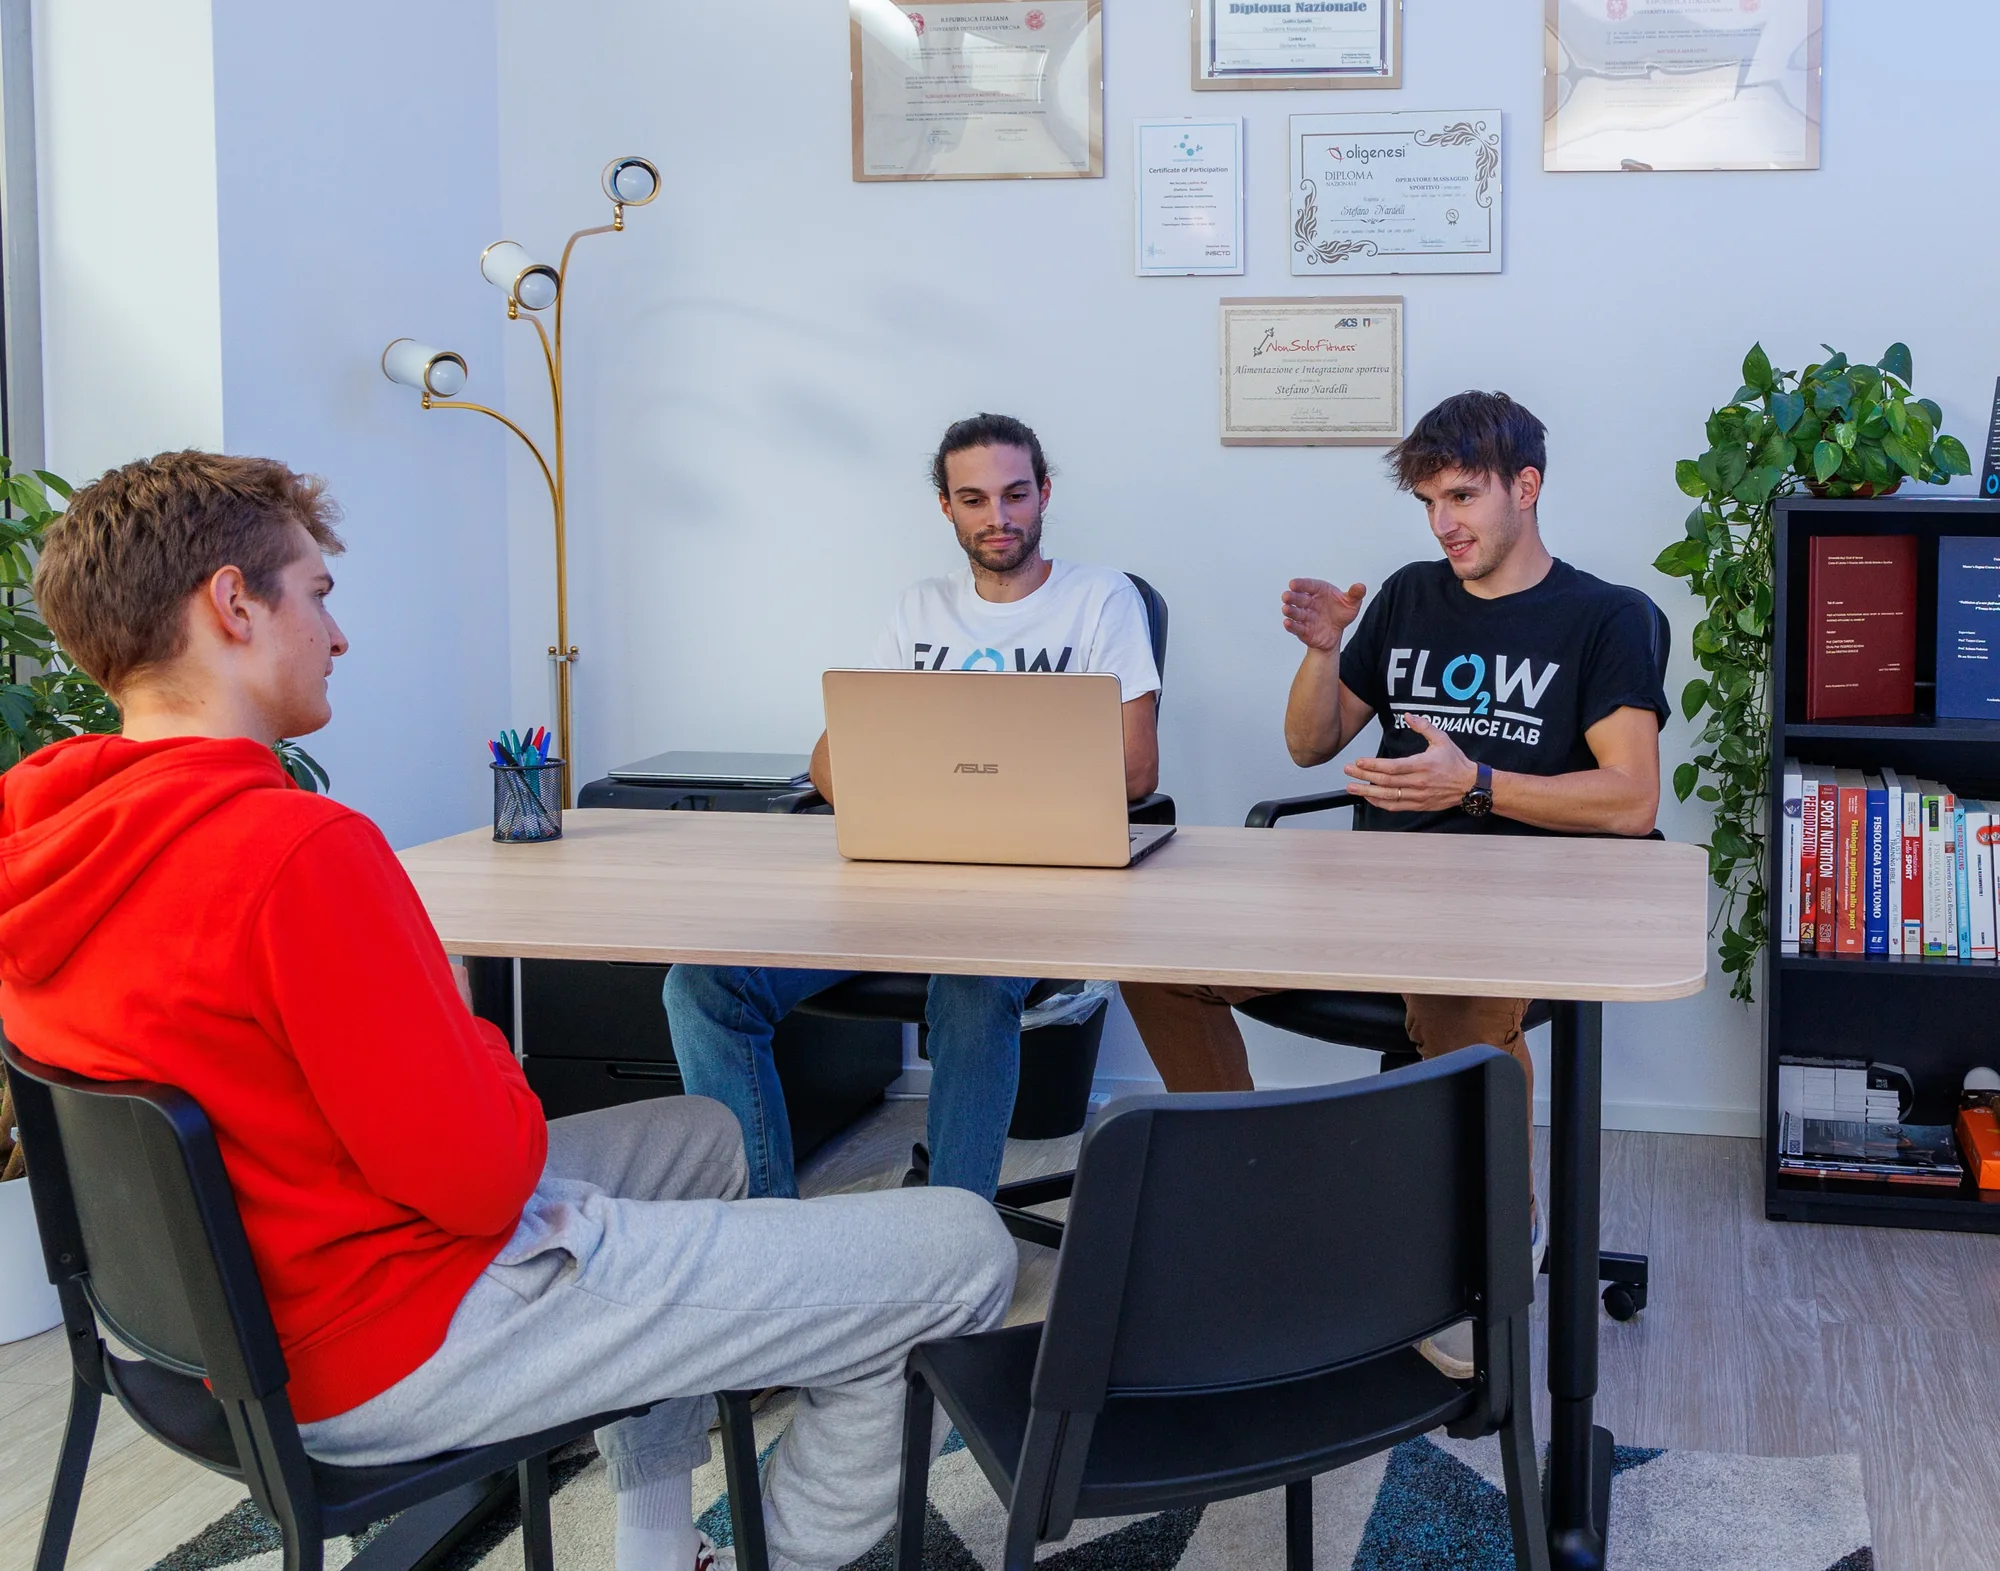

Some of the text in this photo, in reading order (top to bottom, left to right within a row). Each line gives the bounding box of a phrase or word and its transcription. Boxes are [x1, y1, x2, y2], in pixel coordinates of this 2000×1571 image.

[1229, 1, 1367, 14] Diploma Nazionale
[1346, 144, 1406, 164] oligenesi
[1189, 166, 1228, 174] Participation
[1324, 170, 1374, 180] DIPLOMA
[1340, 204, 1406, 218] Stefano Nardelli
[1233, 364, 1293, 376] Alimentazione
[1302, 365, 1354, 376] Integrazione
[1355, 364, 1390, 376] sportiva
[1274, 384, 1348, 396] Stefano Nardelli
[1502, 722, 1541, 746] LAB
[953, 763, 998, 774] ASUS
[1802, 795, 1816, 859] PERIODIZATION
[1820, 800, 1834, 878] SPORT NUTRITION
[1850, 820, 1858, 856] Fisiologia
[1848, 857, 1858, 892] applicata
[1873, 816, 1882, 918] FISIOLOGIA DELL'UOMO
[1848, 910, 1856, 930] sport
